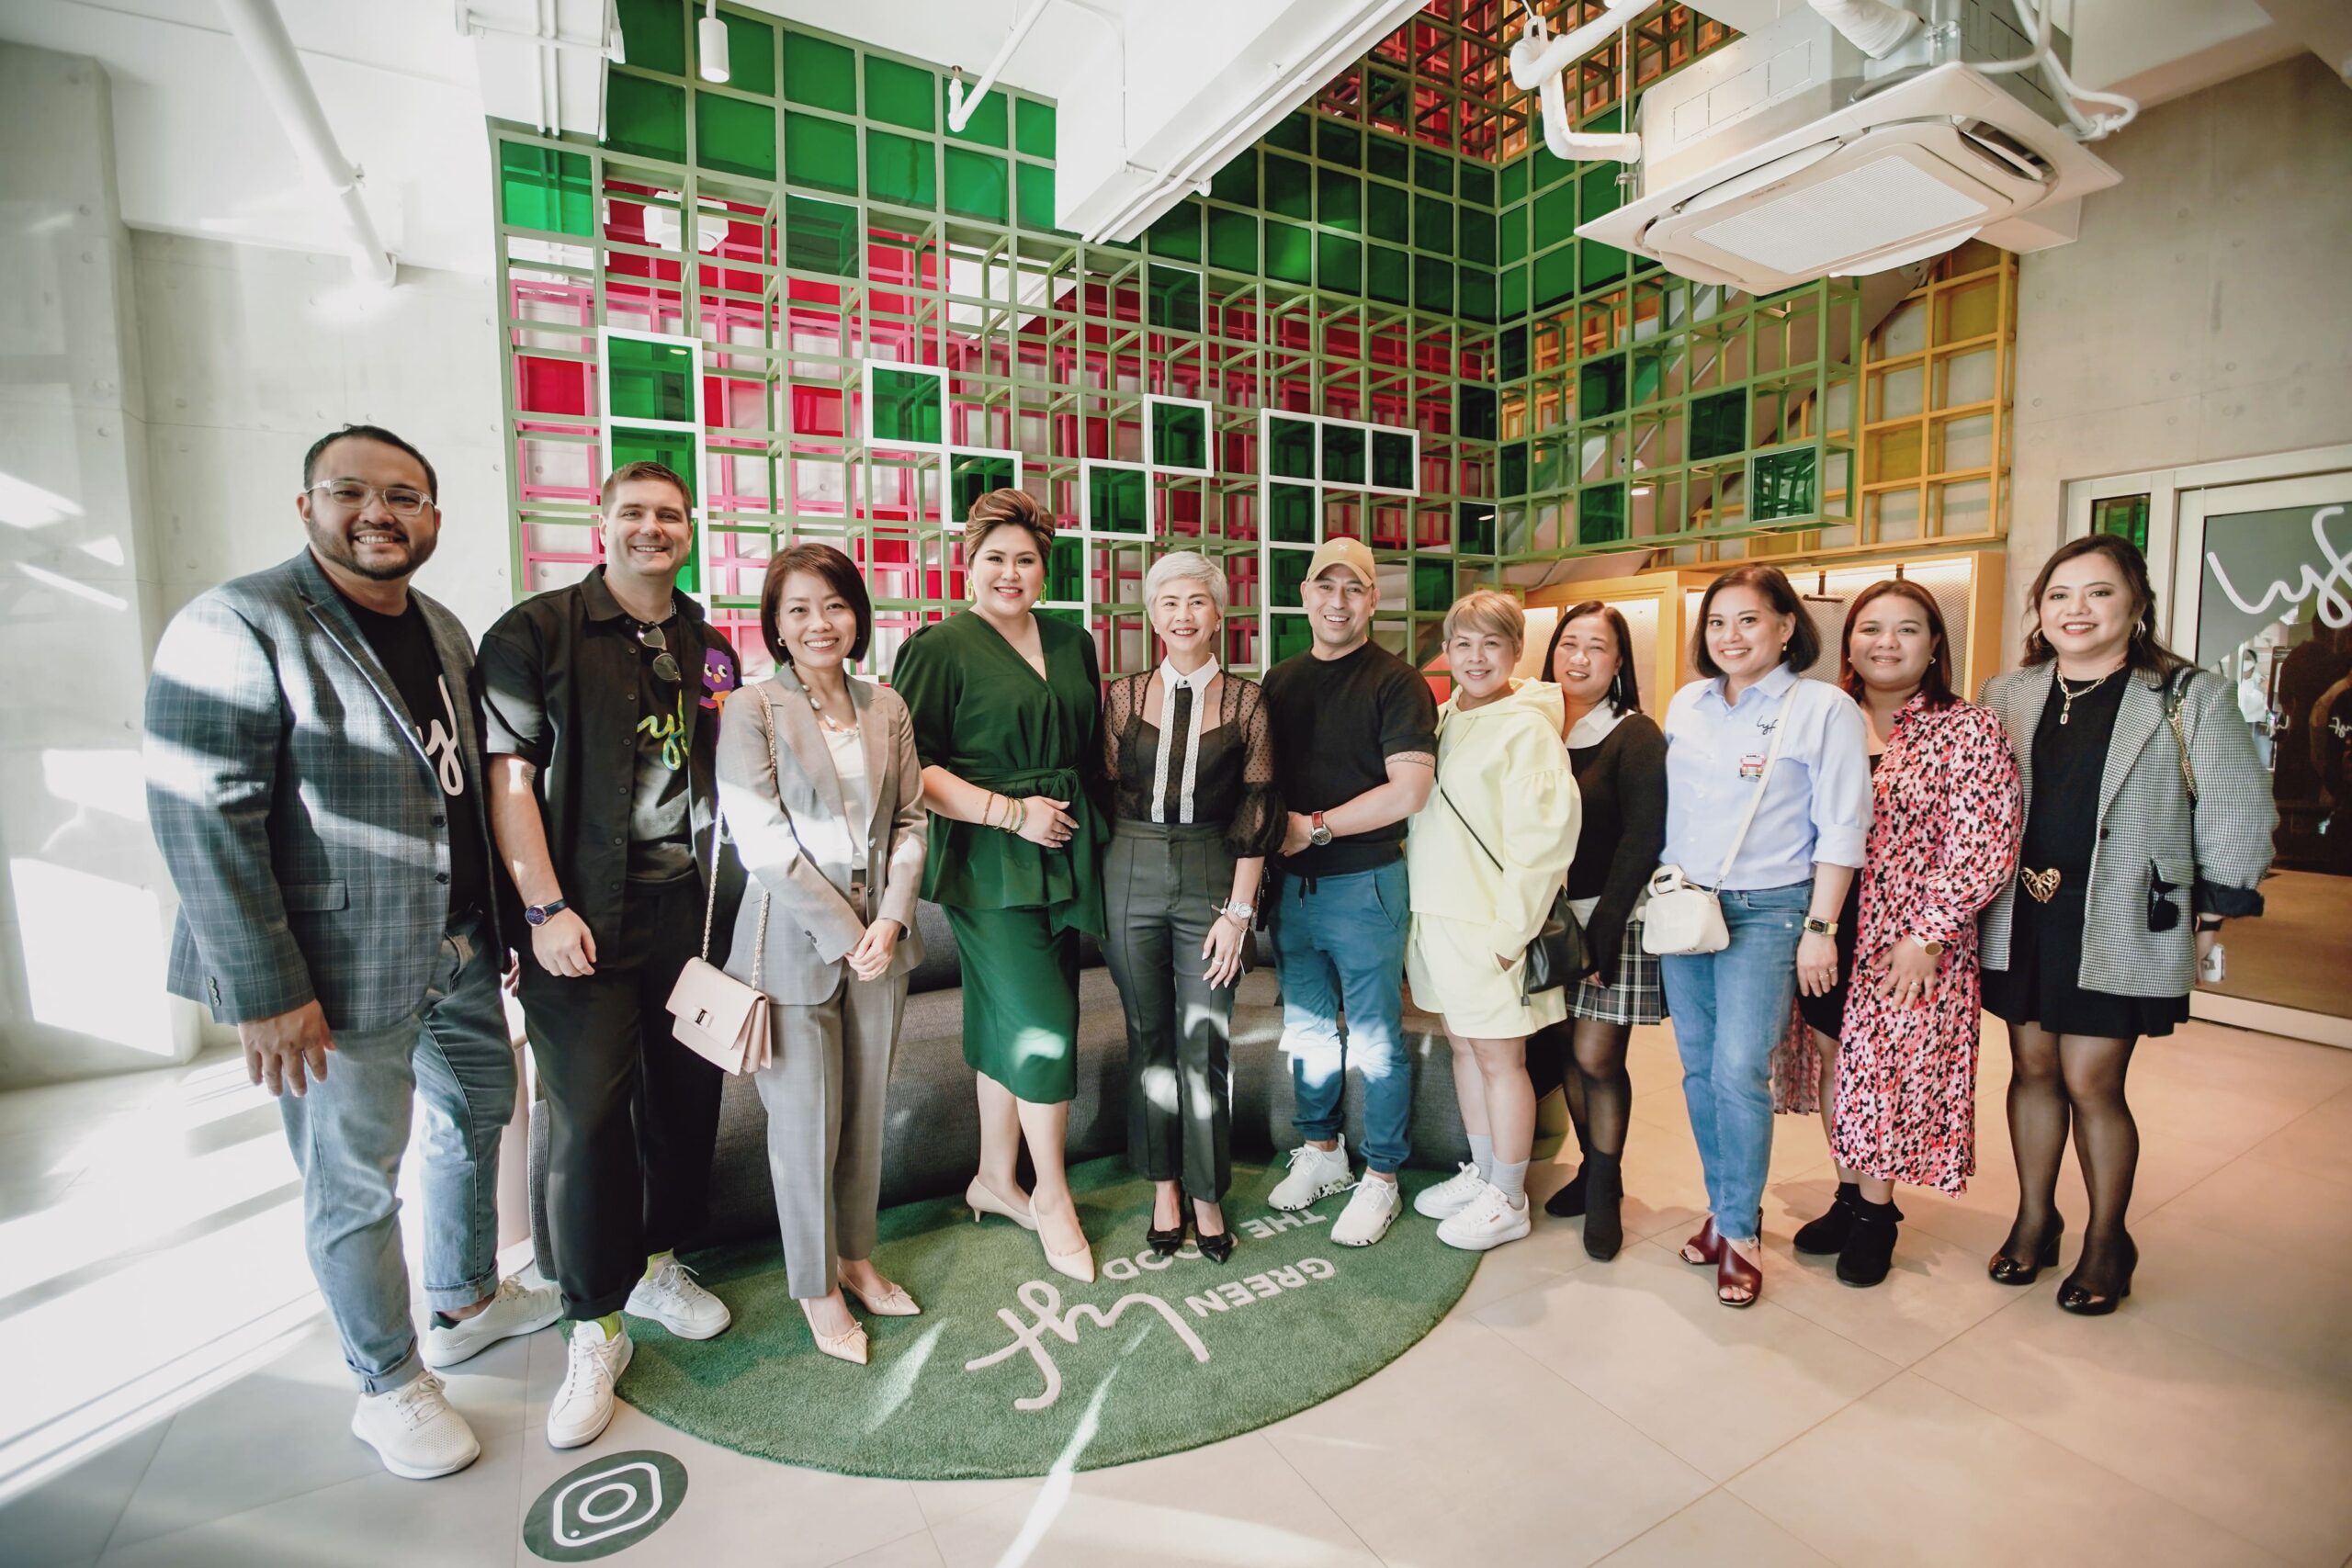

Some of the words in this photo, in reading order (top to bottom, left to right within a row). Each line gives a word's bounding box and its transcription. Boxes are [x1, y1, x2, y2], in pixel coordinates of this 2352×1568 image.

[2206, 506, 2352, 629] lyf
[1757, 715, 1780, 736] lyf
[1239, 1209, 1327, 1238] THE
[1102, 1232, 1238, 1280] OOD
[1184, 1257, 1337, 1318] GREEN
[965, 1280, 1211, 1411] lyf
